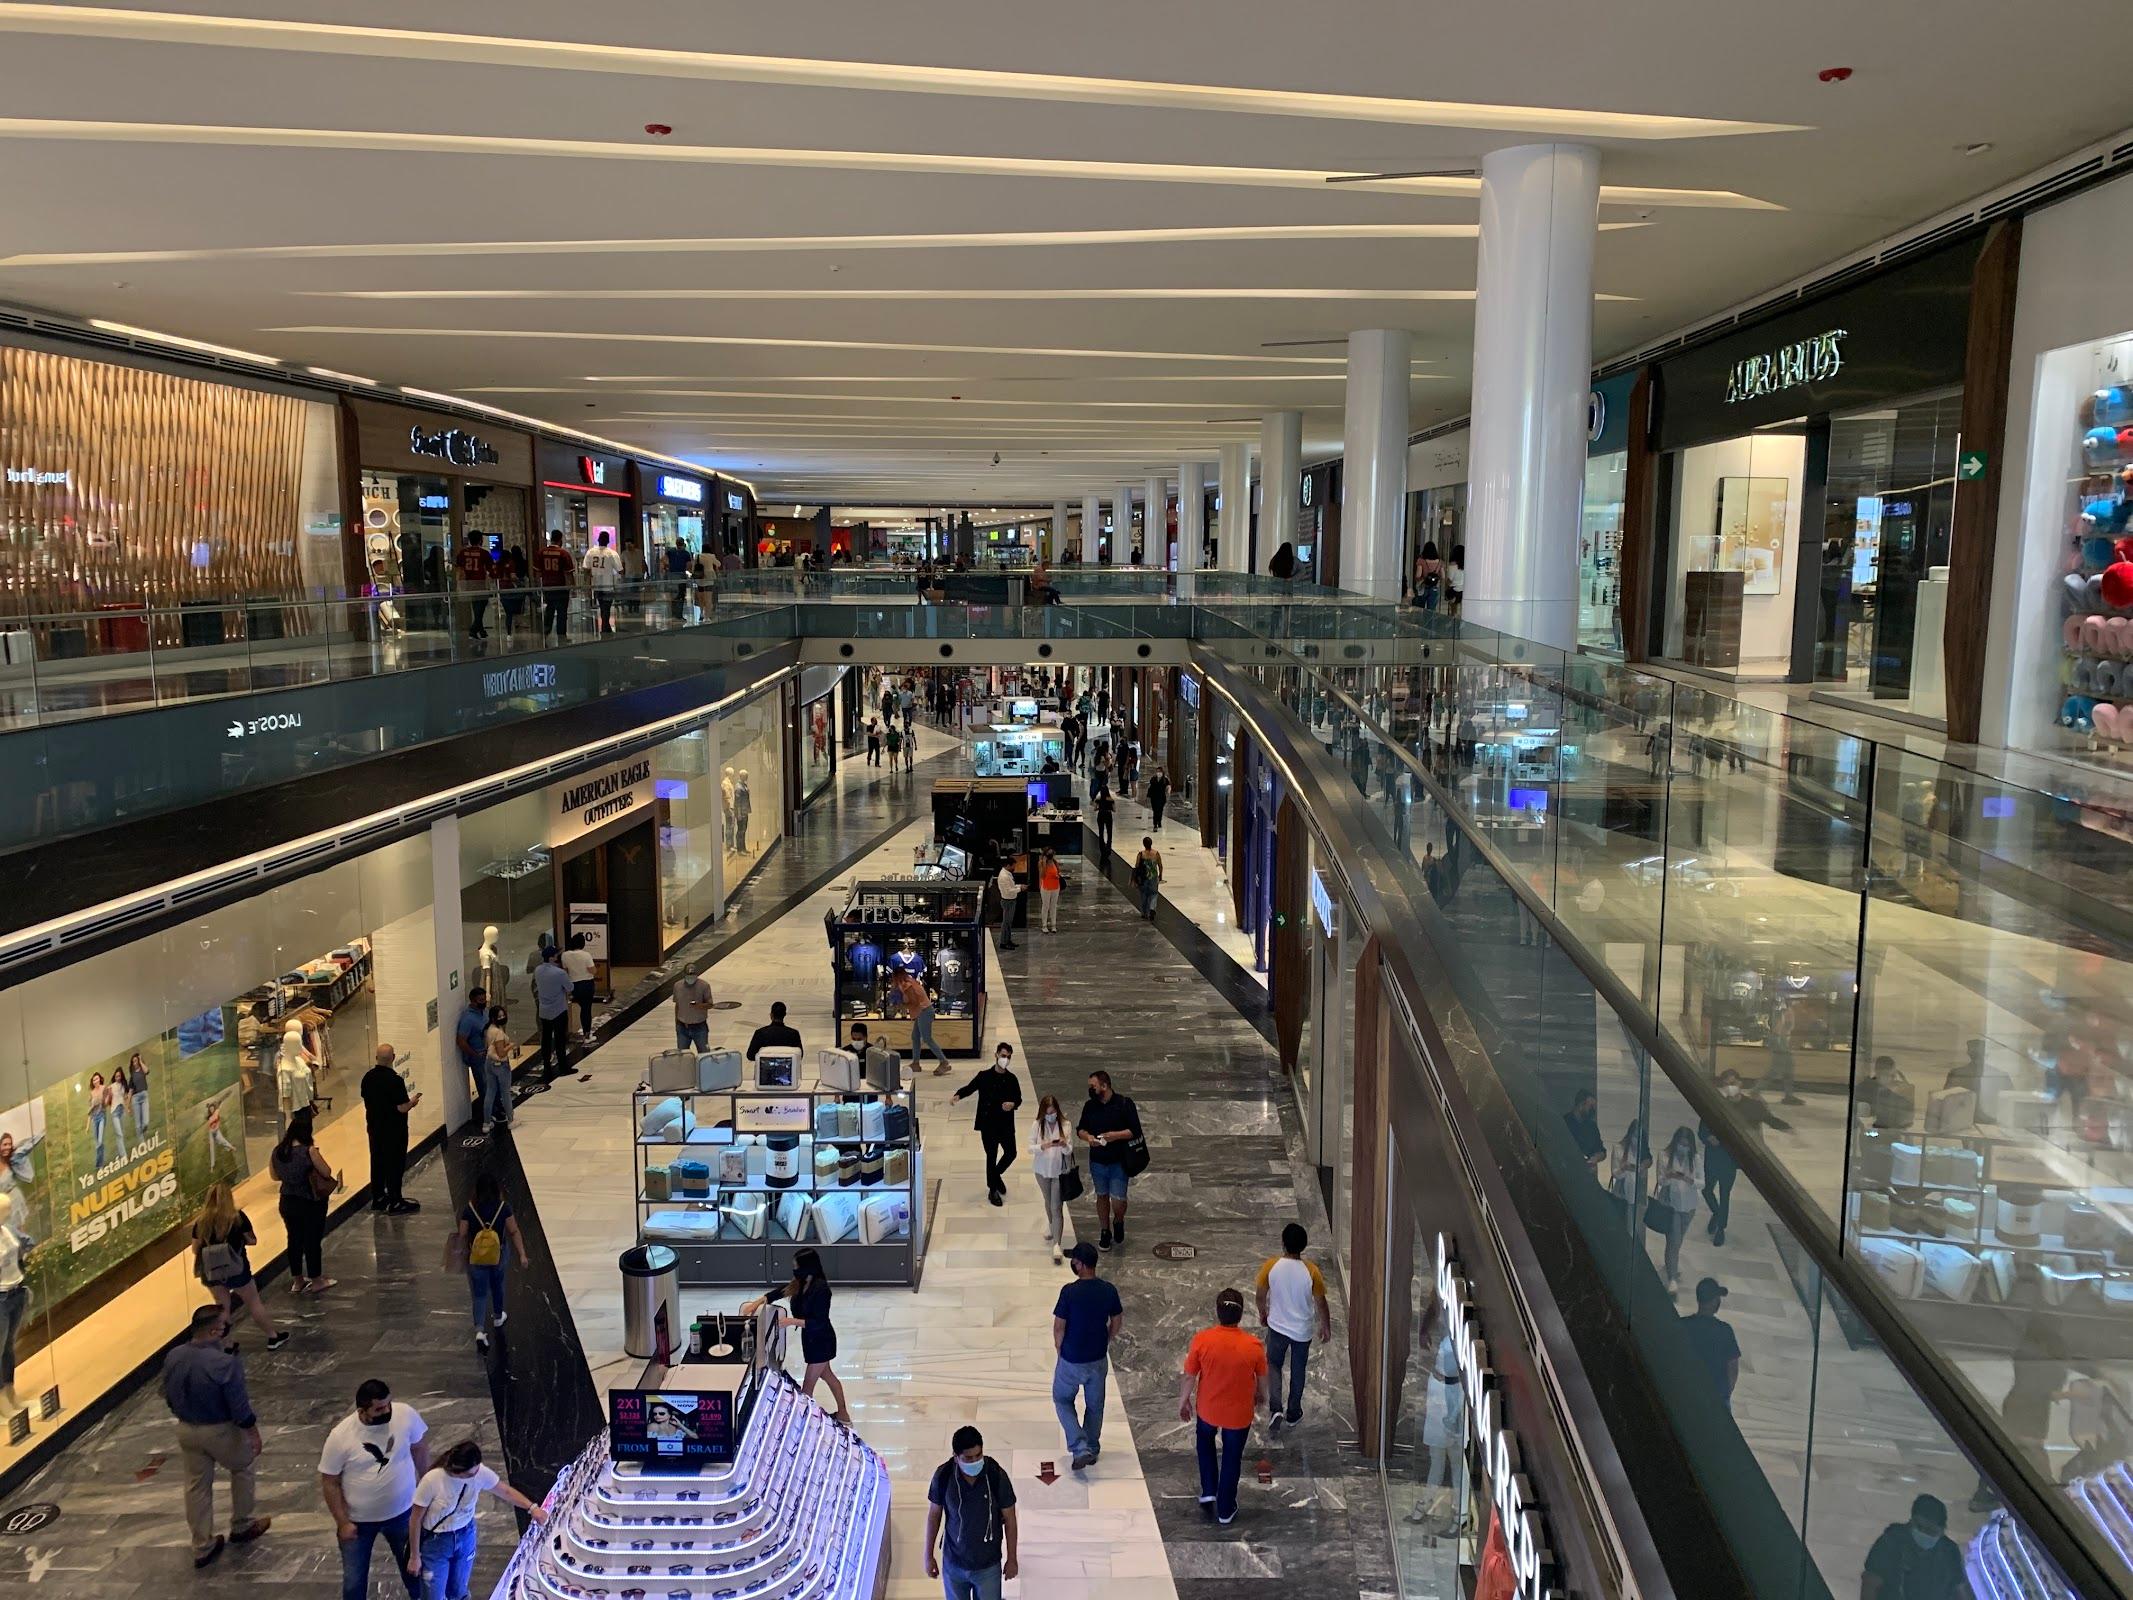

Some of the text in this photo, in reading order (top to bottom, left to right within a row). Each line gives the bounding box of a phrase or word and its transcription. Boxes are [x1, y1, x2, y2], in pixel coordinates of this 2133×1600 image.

[561, 760, 650, 814] AMERICAN EAGLE
[584, 791, 634, 826] OUTFITTERS
[856, 905, 903, 924] TEC
[70, 1148, 175, 1226] NUEVOS
[78, 1172, 95, 1190] Ya
[96, 1155, 129, 1181] están
[70, 1172, 178, 1254] ESTILOS
[617, 1398, 641, 1410] 2X1
[698, 1399, 722, 1411] 2X1
[617, 1443, 727, 1454] FROM ISRAEL
